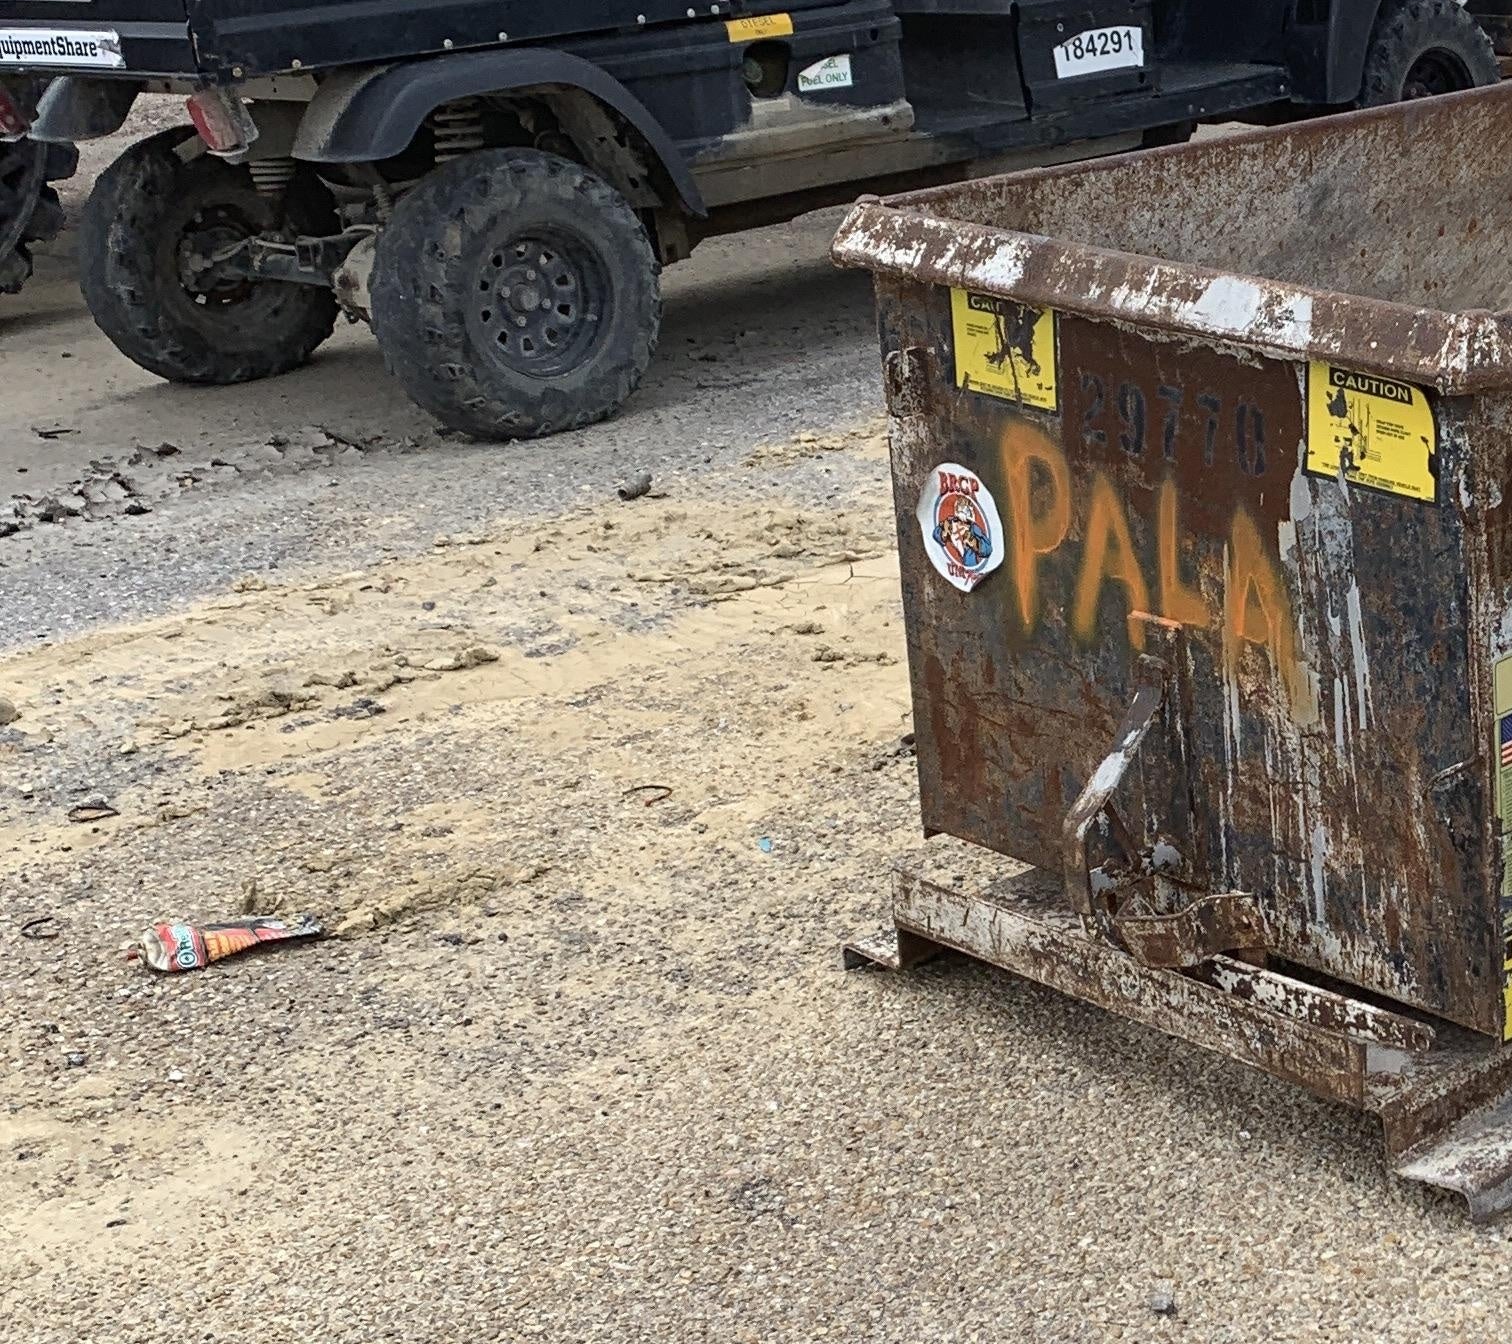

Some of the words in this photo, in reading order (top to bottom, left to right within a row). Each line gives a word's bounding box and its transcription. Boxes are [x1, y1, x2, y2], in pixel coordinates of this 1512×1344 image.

[740, 16, 777, 28] DIESEL
[0, 36, 98, 60] uipmentShare
[1060, 30, 1133, 62] 184291
[826, 71, 848, 84] ONLY
[1333, 371, 1410, 402] CAUTION
[1080, 373, 1266, 477] 29770
[1000, 421, 1312, 716] PALA
